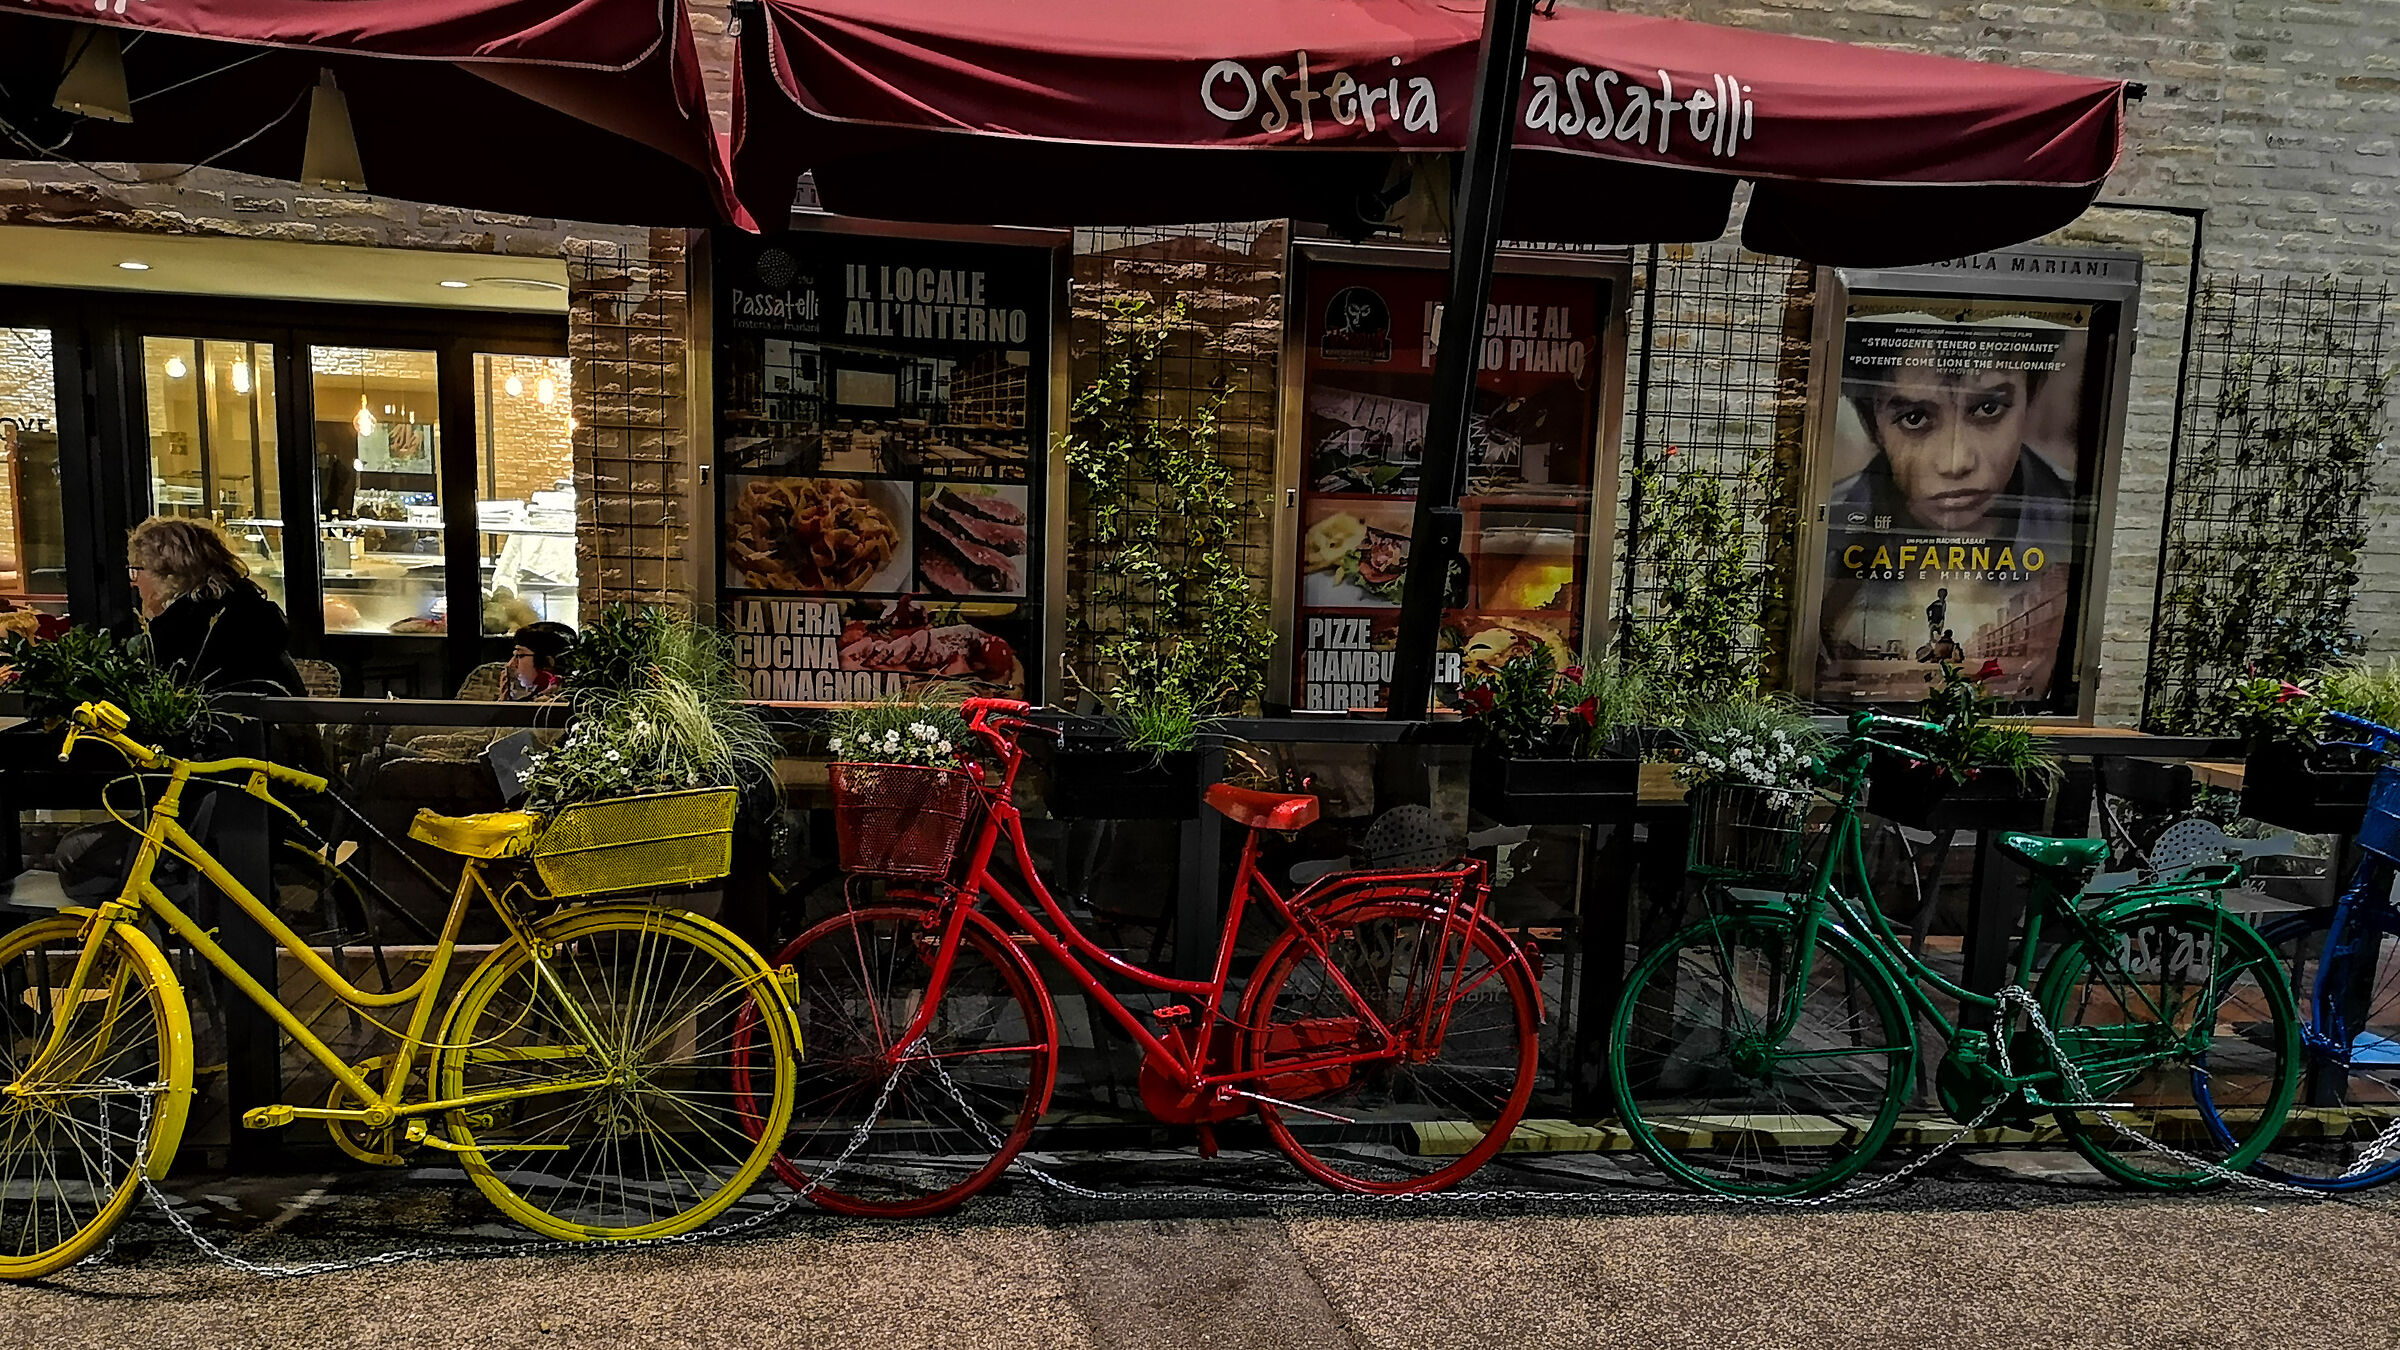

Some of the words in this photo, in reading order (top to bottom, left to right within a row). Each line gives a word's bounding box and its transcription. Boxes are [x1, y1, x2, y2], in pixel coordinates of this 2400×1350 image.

[1201, 50, 1438, 140] Osteria
[1521, 55, 1754, 157] assatelli
[2011, 258, 2109, 277] MARIANI
[846, 264, 871, 299] IL
[881, 266, 986, 305] LOCALE
[732, 288, 820, 321] Passatelli
[845, 300, 1027, 343] ALL'INTERNO
[1483, 304, 1539, 338] CALE
[1542, 306, 1572, 339] AL
[1509, 339, 1585, 374] PIANO
[1936, 339, 1977, 351] TENERO
[1905, 357, 1934, 368] COME
[1973, 359, 1993, 369] THE
[1843, 544, 2045, 572] CAFARNAO
[1855, 570, 1905, 580] CAOS
[1919, 571, 1926, 580] E
[1940, 571, 2030, 581] MIRACOLI
[734, 600, 765, 633] LA
[770, 601, 841, 636] VERA
[1307, 618, 1371, 650] PIZZE
[734, 635, 839, 669] CUCINA
[1306, 650, 1461, 683] HAMBUER
